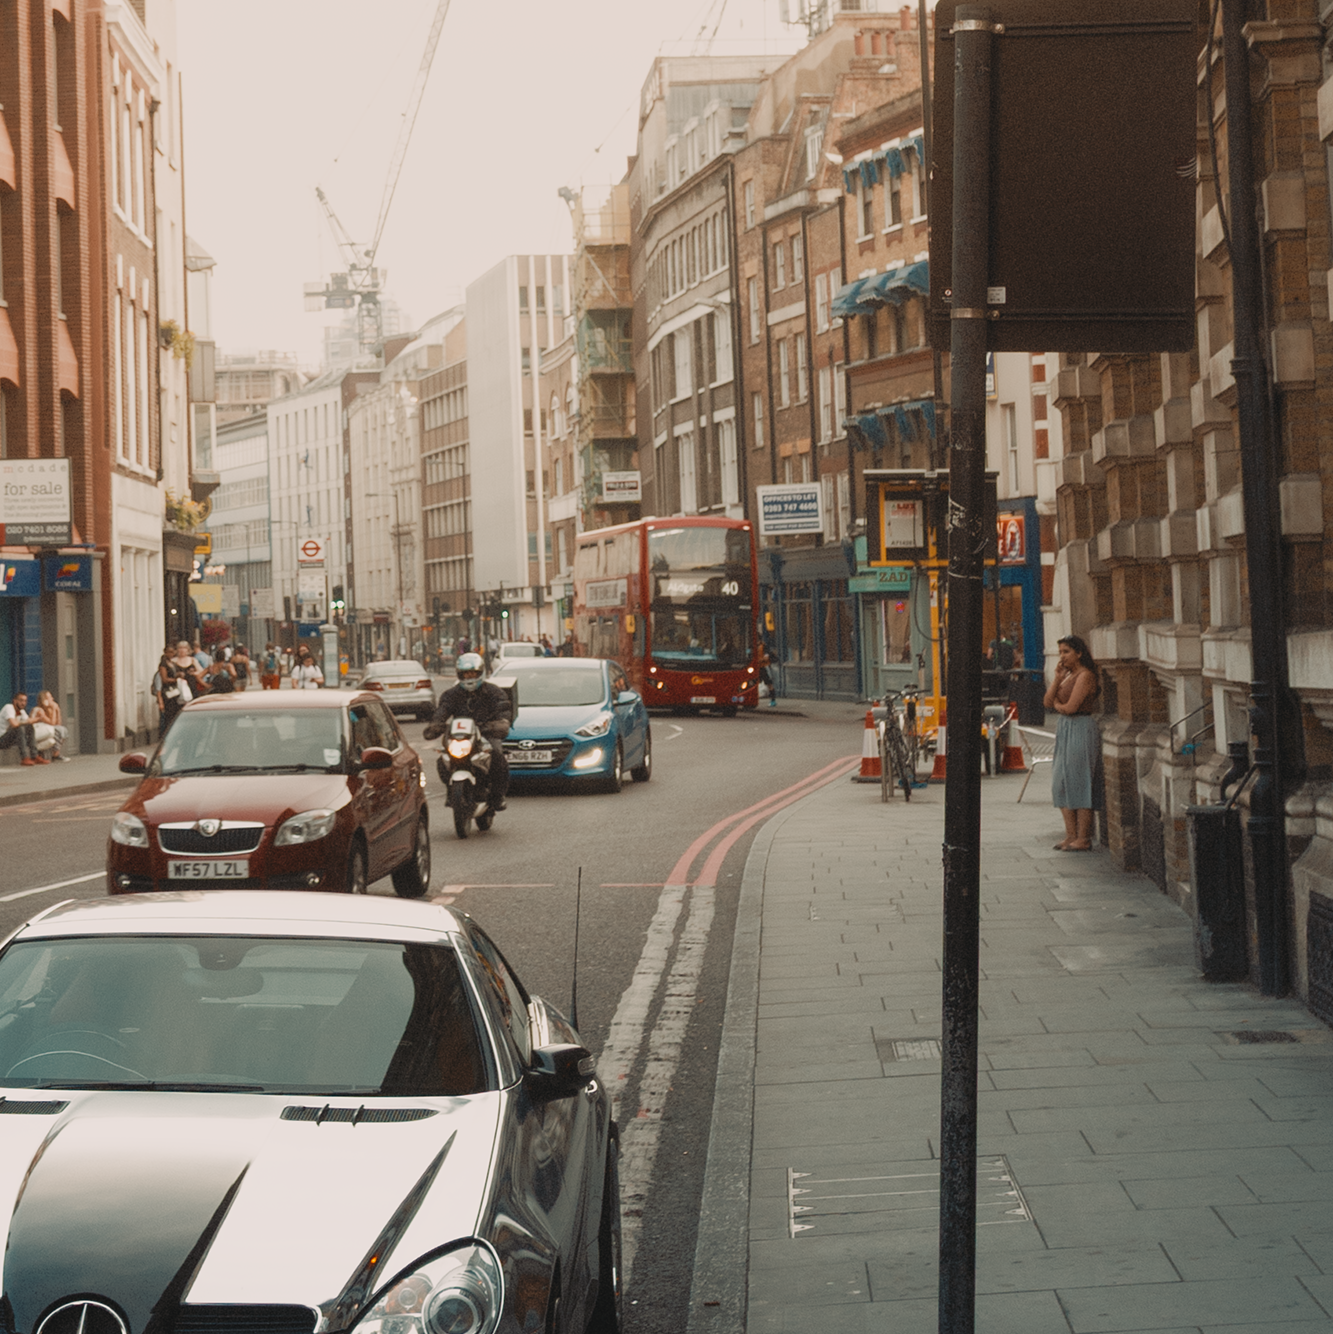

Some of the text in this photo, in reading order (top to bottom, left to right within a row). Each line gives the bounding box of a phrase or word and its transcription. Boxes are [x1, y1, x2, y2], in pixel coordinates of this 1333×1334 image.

[4, 481, 63, 496] for sale
[763, 495, 792, 504] OFFICES
[784, 503, 798, 511] 747
[879, 572, 908, 582] ZAD
[667, 581, 739, 595] Aldgate 40
[457, 722, 466, 730] L
[173, 862, 243, 876] WF57 LZL
